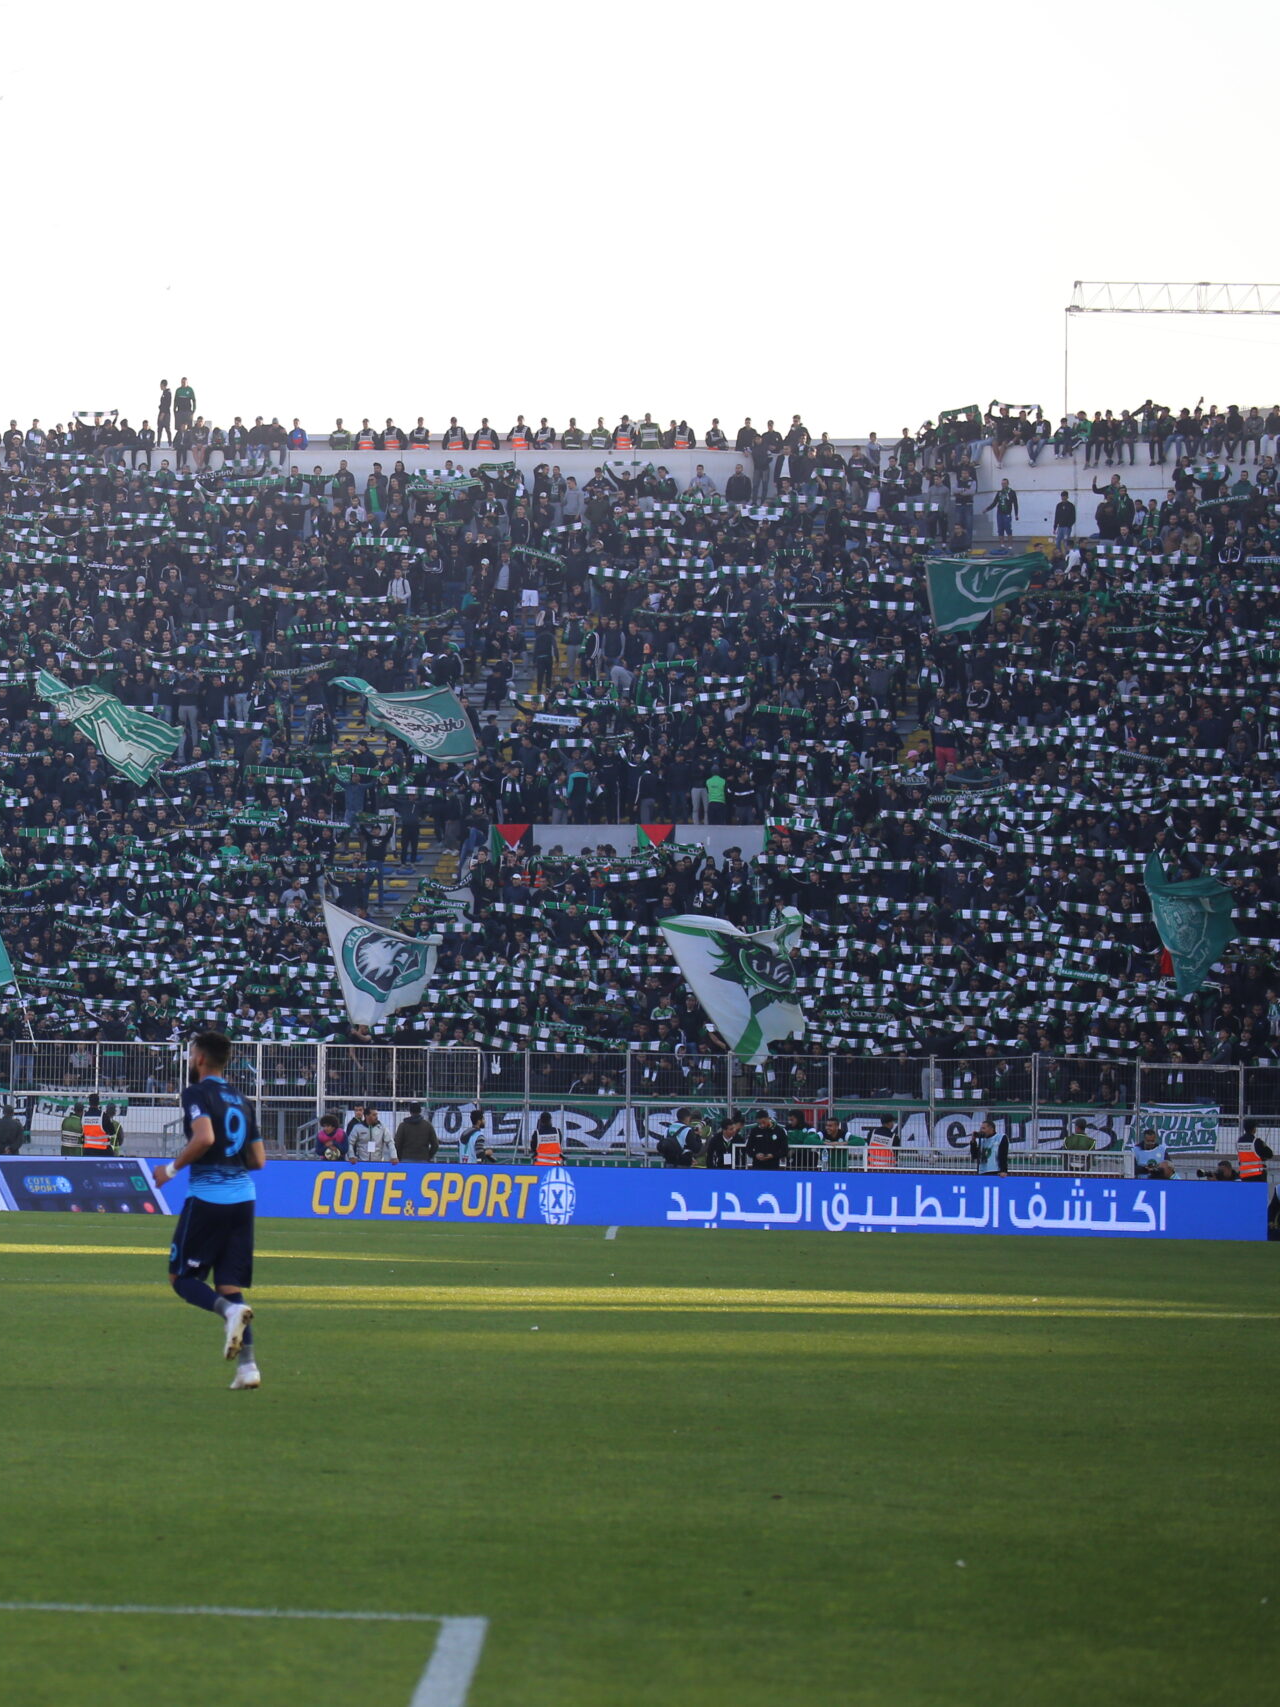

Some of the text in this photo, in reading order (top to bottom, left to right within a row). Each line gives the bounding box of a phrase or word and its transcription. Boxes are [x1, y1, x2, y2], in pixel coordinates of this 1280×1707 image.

[224, 1106, 247, 1158] 9
[665, 1178, 1167, 1234] اكتشف التطبيق الجديد
